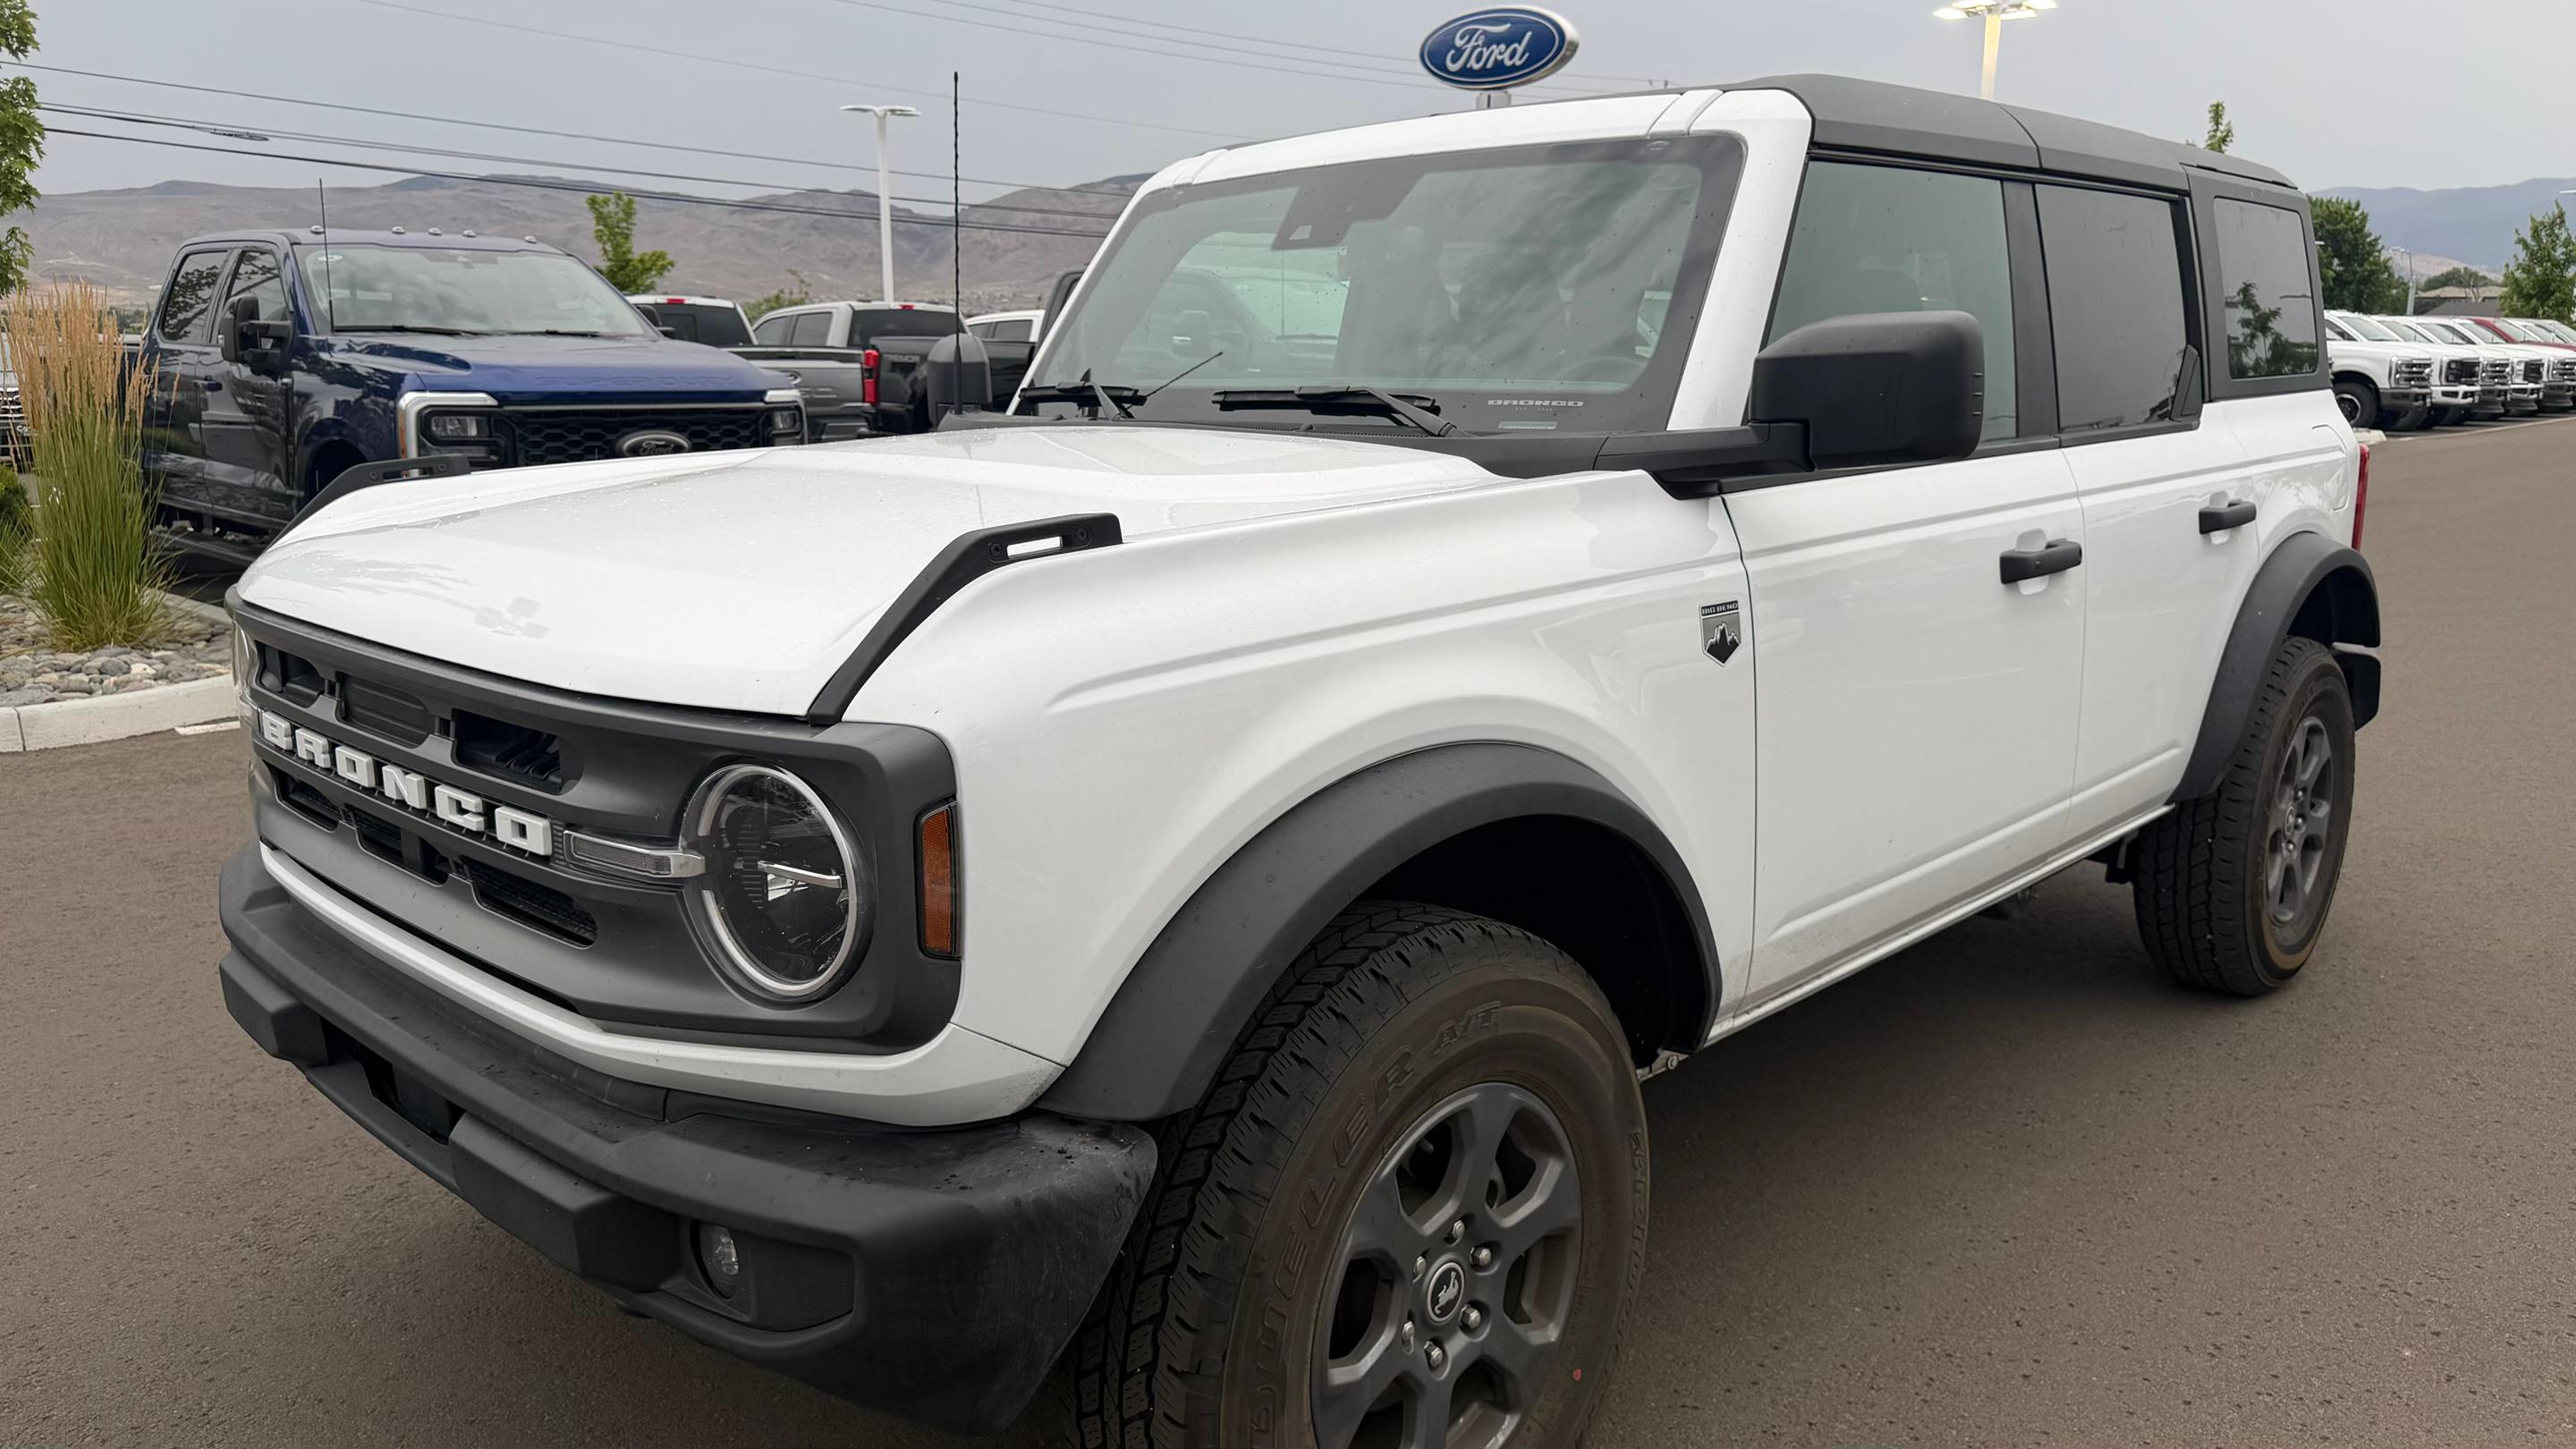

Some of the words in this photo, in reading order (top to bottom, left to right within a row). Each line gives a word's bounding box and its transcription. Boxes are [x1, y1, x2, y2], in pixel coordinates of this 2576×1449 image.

[1445, 23, 1533, 72] Ford
[534, 376, 653, 388] SUPER
[657, 376, 735, 388] DUTY
[1487, 399, 1584, 407] BRONCO
[1716, 602, 1738, 613] BEND
[261, 710, 553, 857] BRONCO
